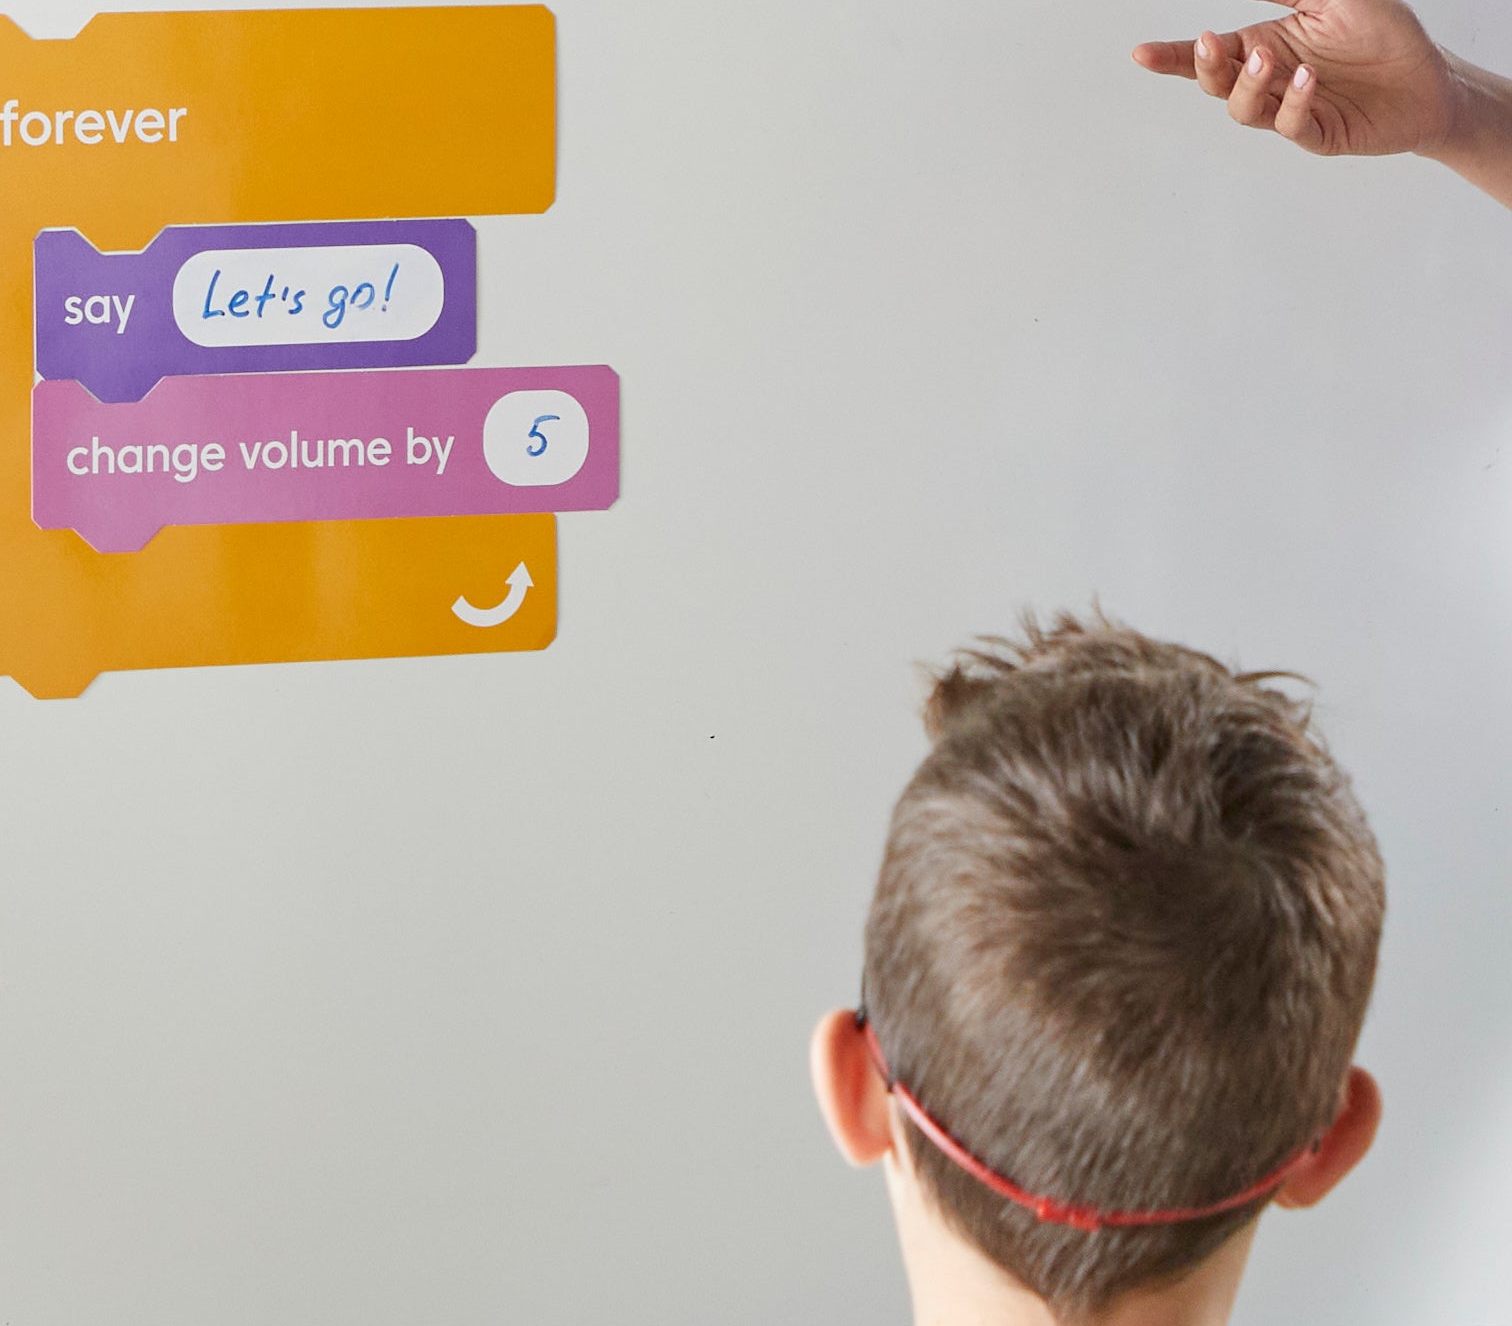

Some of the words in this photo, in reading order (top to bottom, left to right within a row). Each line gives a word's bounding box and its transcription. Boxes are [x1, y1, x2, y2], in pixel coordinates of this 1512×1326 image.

[64, 294, 136, 335] say
[202, 269, 306, 320] Let's
[322, 263, 400, 329] go!
[66, 436, 226, 484] change
[239, 430, 393, 470] volume
[406, 426, 455, 475] by
[527, 414, 560, 457] 5
